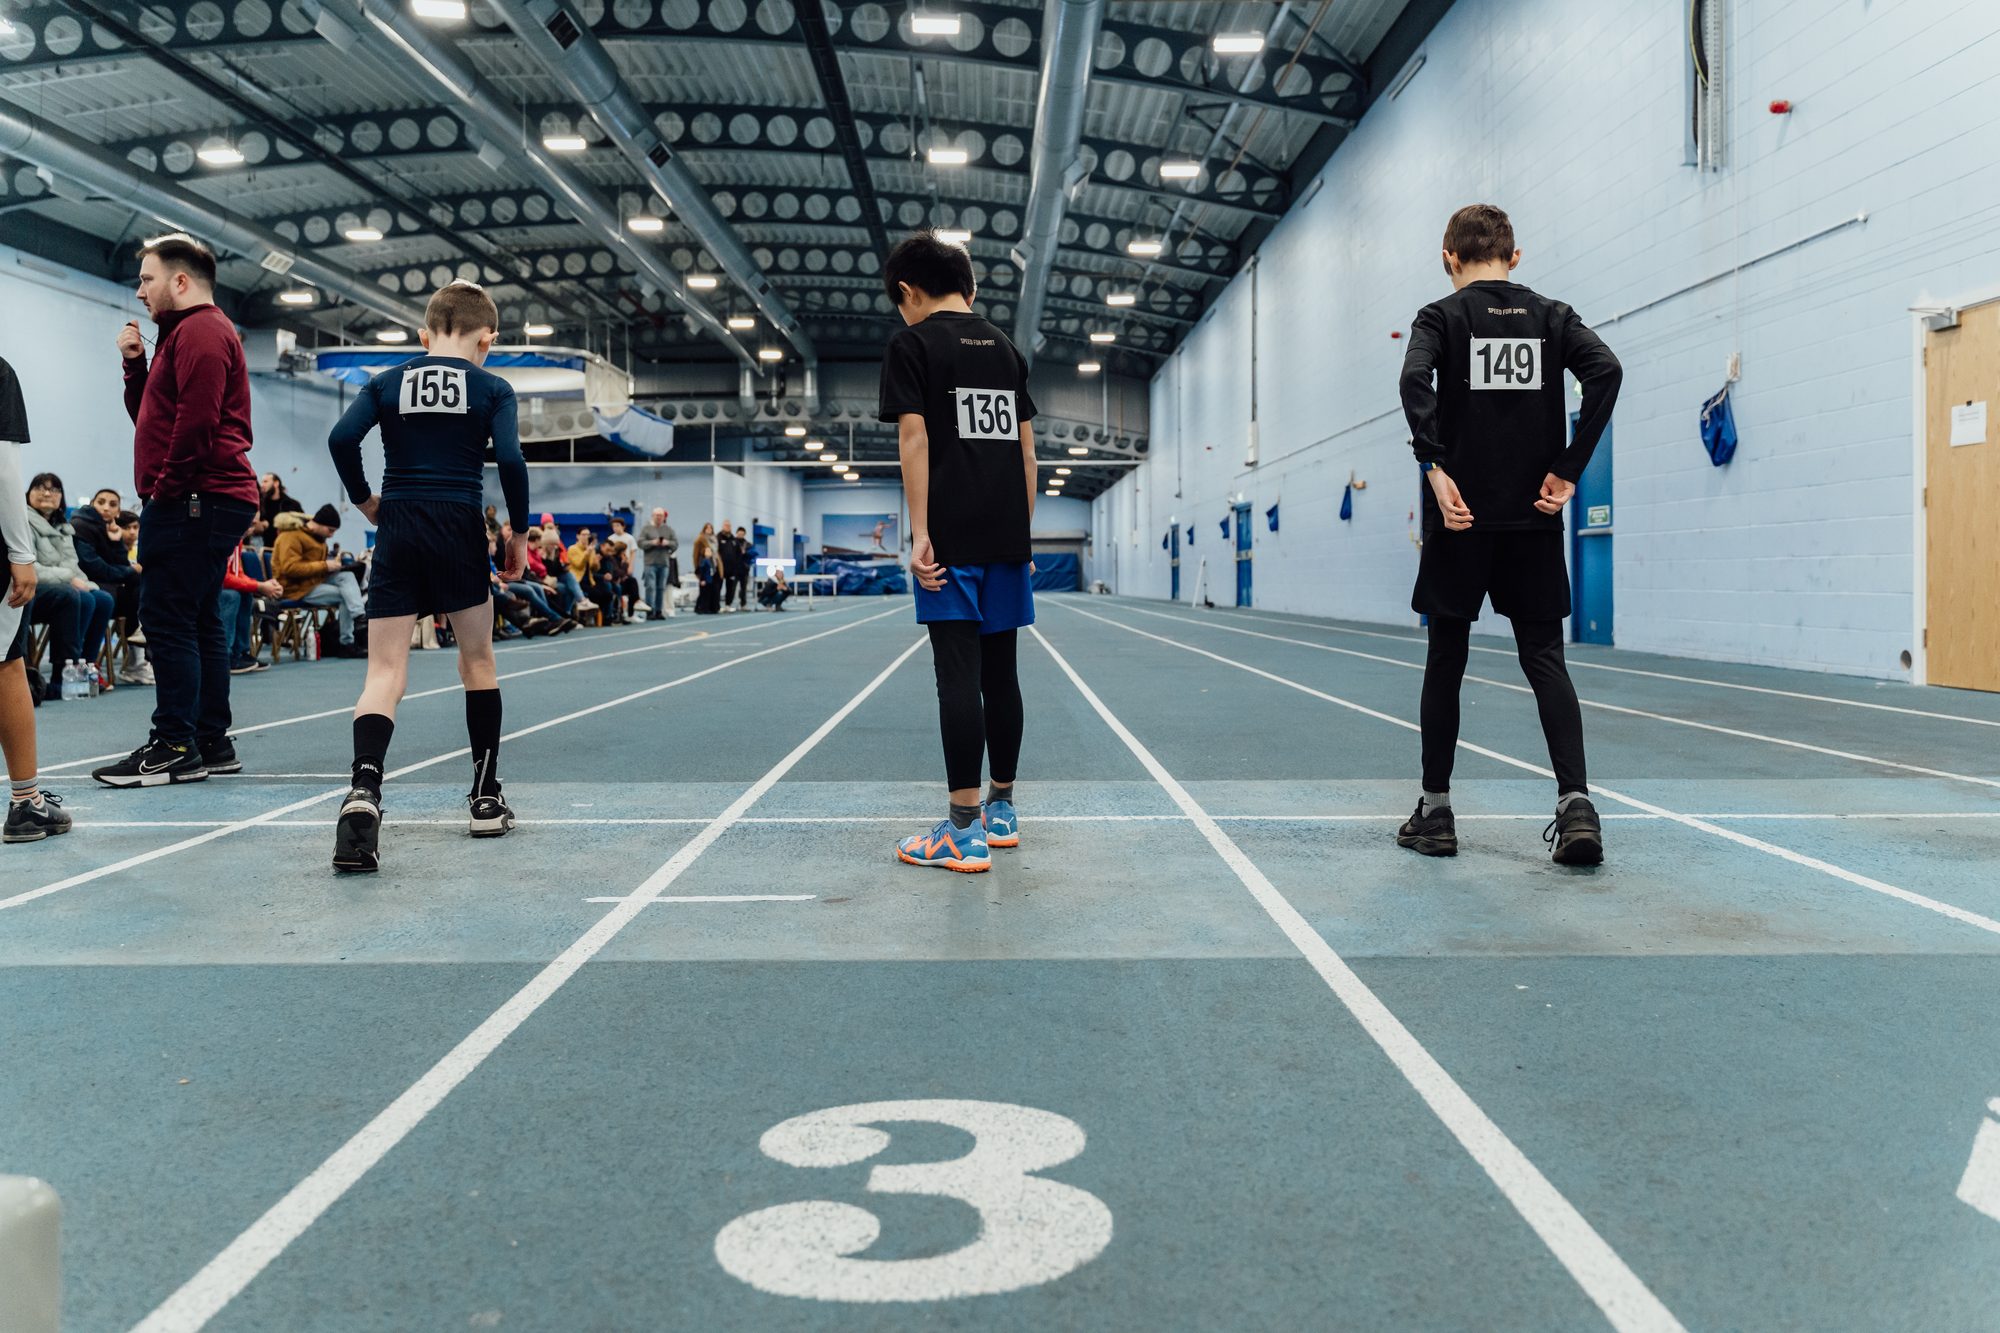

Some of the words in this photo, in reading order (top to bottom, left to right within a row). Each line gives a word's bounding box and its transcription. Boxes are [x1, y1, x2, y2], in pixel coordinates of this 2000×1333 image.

[1487, 307, 1502, 315] SPEED
[1476, 343, 1534, 385] 149
[406, 369, 460, 408] 155
[961, 393, 1012, 435] 136
[714, 1099, 1113, 1302] 3
